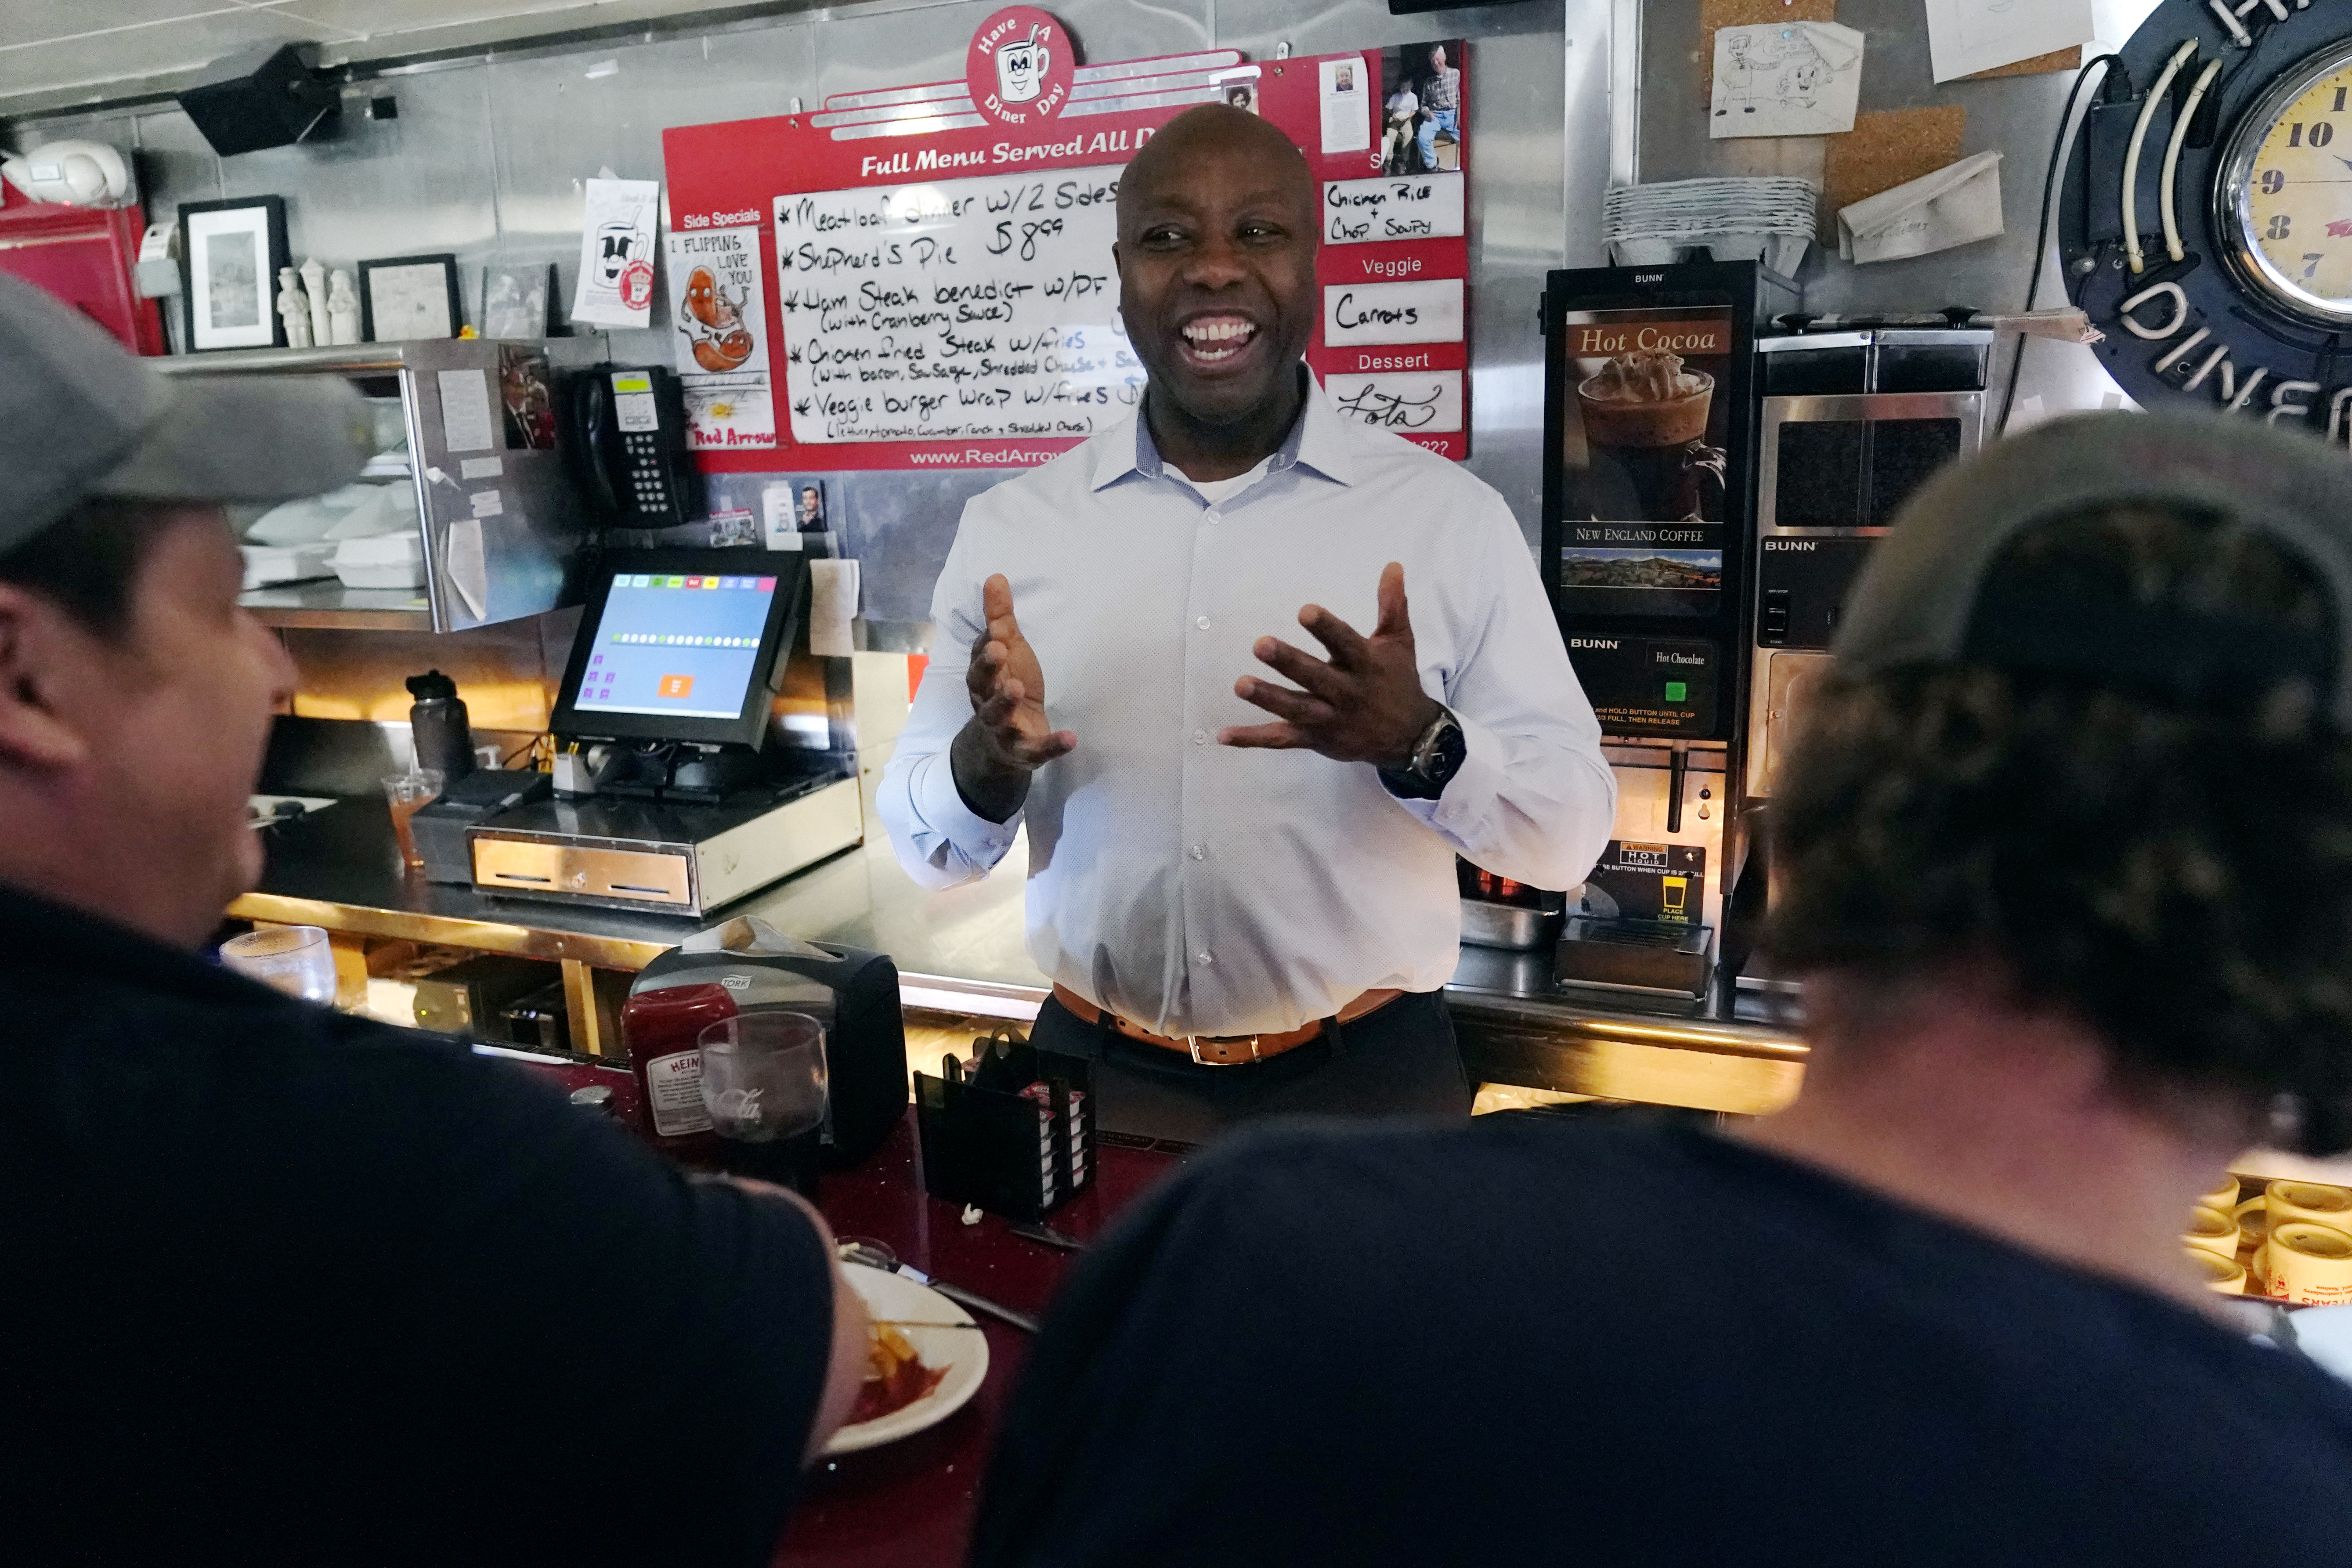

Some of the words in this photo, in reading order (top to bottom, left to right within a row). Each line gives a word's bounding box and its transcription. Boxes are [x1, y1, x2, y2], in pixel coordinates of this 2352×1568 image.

[978, 19, 1016, 54] Have
[1038, 25, 1051, 41] A
[984, 94, 1026, 123] Diner
[1036, 83, 1064, 116] Day
[2286, 122, 2333, 148] 10
[861, 153, 910, 176] Full
[914, 148, 986, 171] Menu
[992, 135, 1084, 164] Served
[1088, 129, 1129, 154] All
[2262, 170, 2284, 194] 9
[683, 214, 710, 228] Side
[712, 208, 761, 227] Specials
[2266, 215, 2291, 240] 8
[671, 240, 677, 253] I
[684, 235, 741, 253] FLIPPING
[910, 237, 957, 270] Pie
[717, 253, 748, 269] LOVE
[1362, 257, 1422, 276] Veggie
[2302, 253, 2325, 278] 7
[728, 270, 752, 285] YOU
[1635, 274, 1664, 283] BUNN
[859, 281, 919, 311] Steak
[1336, 293, 1418, 329] Carrots
[940, 335, 996, 358] Steak
[1580, 328, 1627, 352] Hot
[1637, 327, 1716, 350] Cocoa
[1359, 353, 1429, 369] Dessert
[815, 392, 873, 425] Veggie
[694, 428, 723, 446] Red
[727, 427, 776, 445] Arrow
[1765, 541, 1816, 551] BUNN
[1571, 638, 1618, 650] BUNN
[1656, 652, 1669, 662] Hot
[1671, 652, 1705, 665] Chocolate
[1628, 852, 1660, 860] HOT
[722, 979, 748, 989] TORK
[671, 1057, 700, 1072] HEIN
